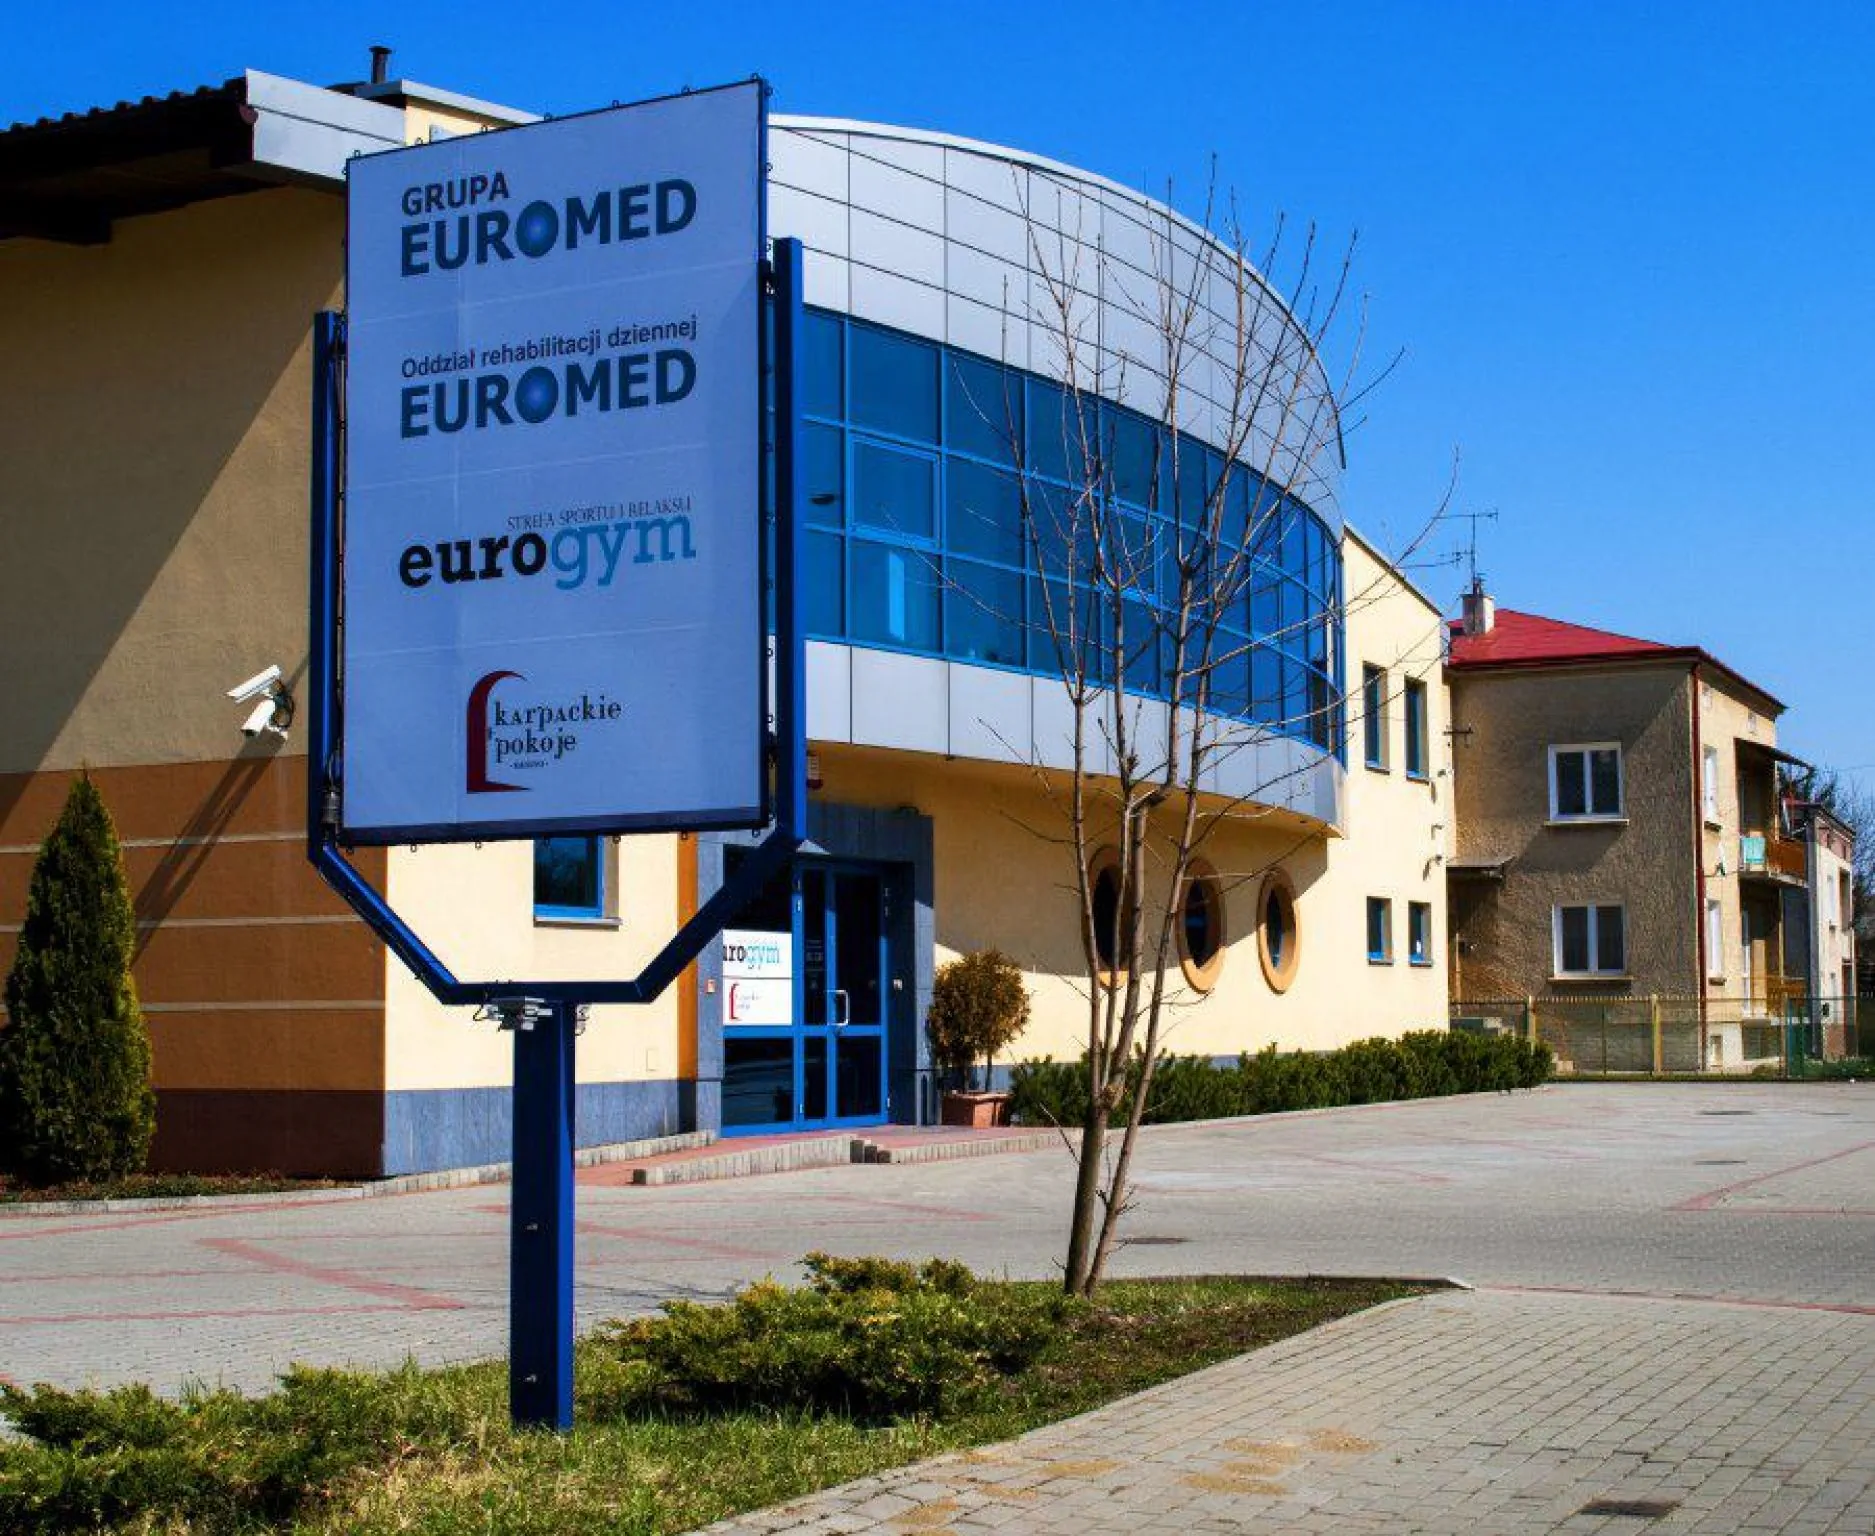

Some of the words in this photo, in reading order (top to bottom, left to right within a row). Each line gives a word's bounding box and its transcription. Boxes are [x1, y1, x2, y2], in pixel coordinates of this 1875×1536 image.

[401, 172, 510, 217] GRUPA
[400, 178, 698, 278] EUROMED
[481, 327, 602, 367] rehabilitacji
[607, 313, 698, 349] dziennej
[400, 348, 698, 439] EUROMED
[399, 513, 697, 590] eurogym
[495, 694, 622, 732] karpackie
[495, 727, 577, 763] pokoje
